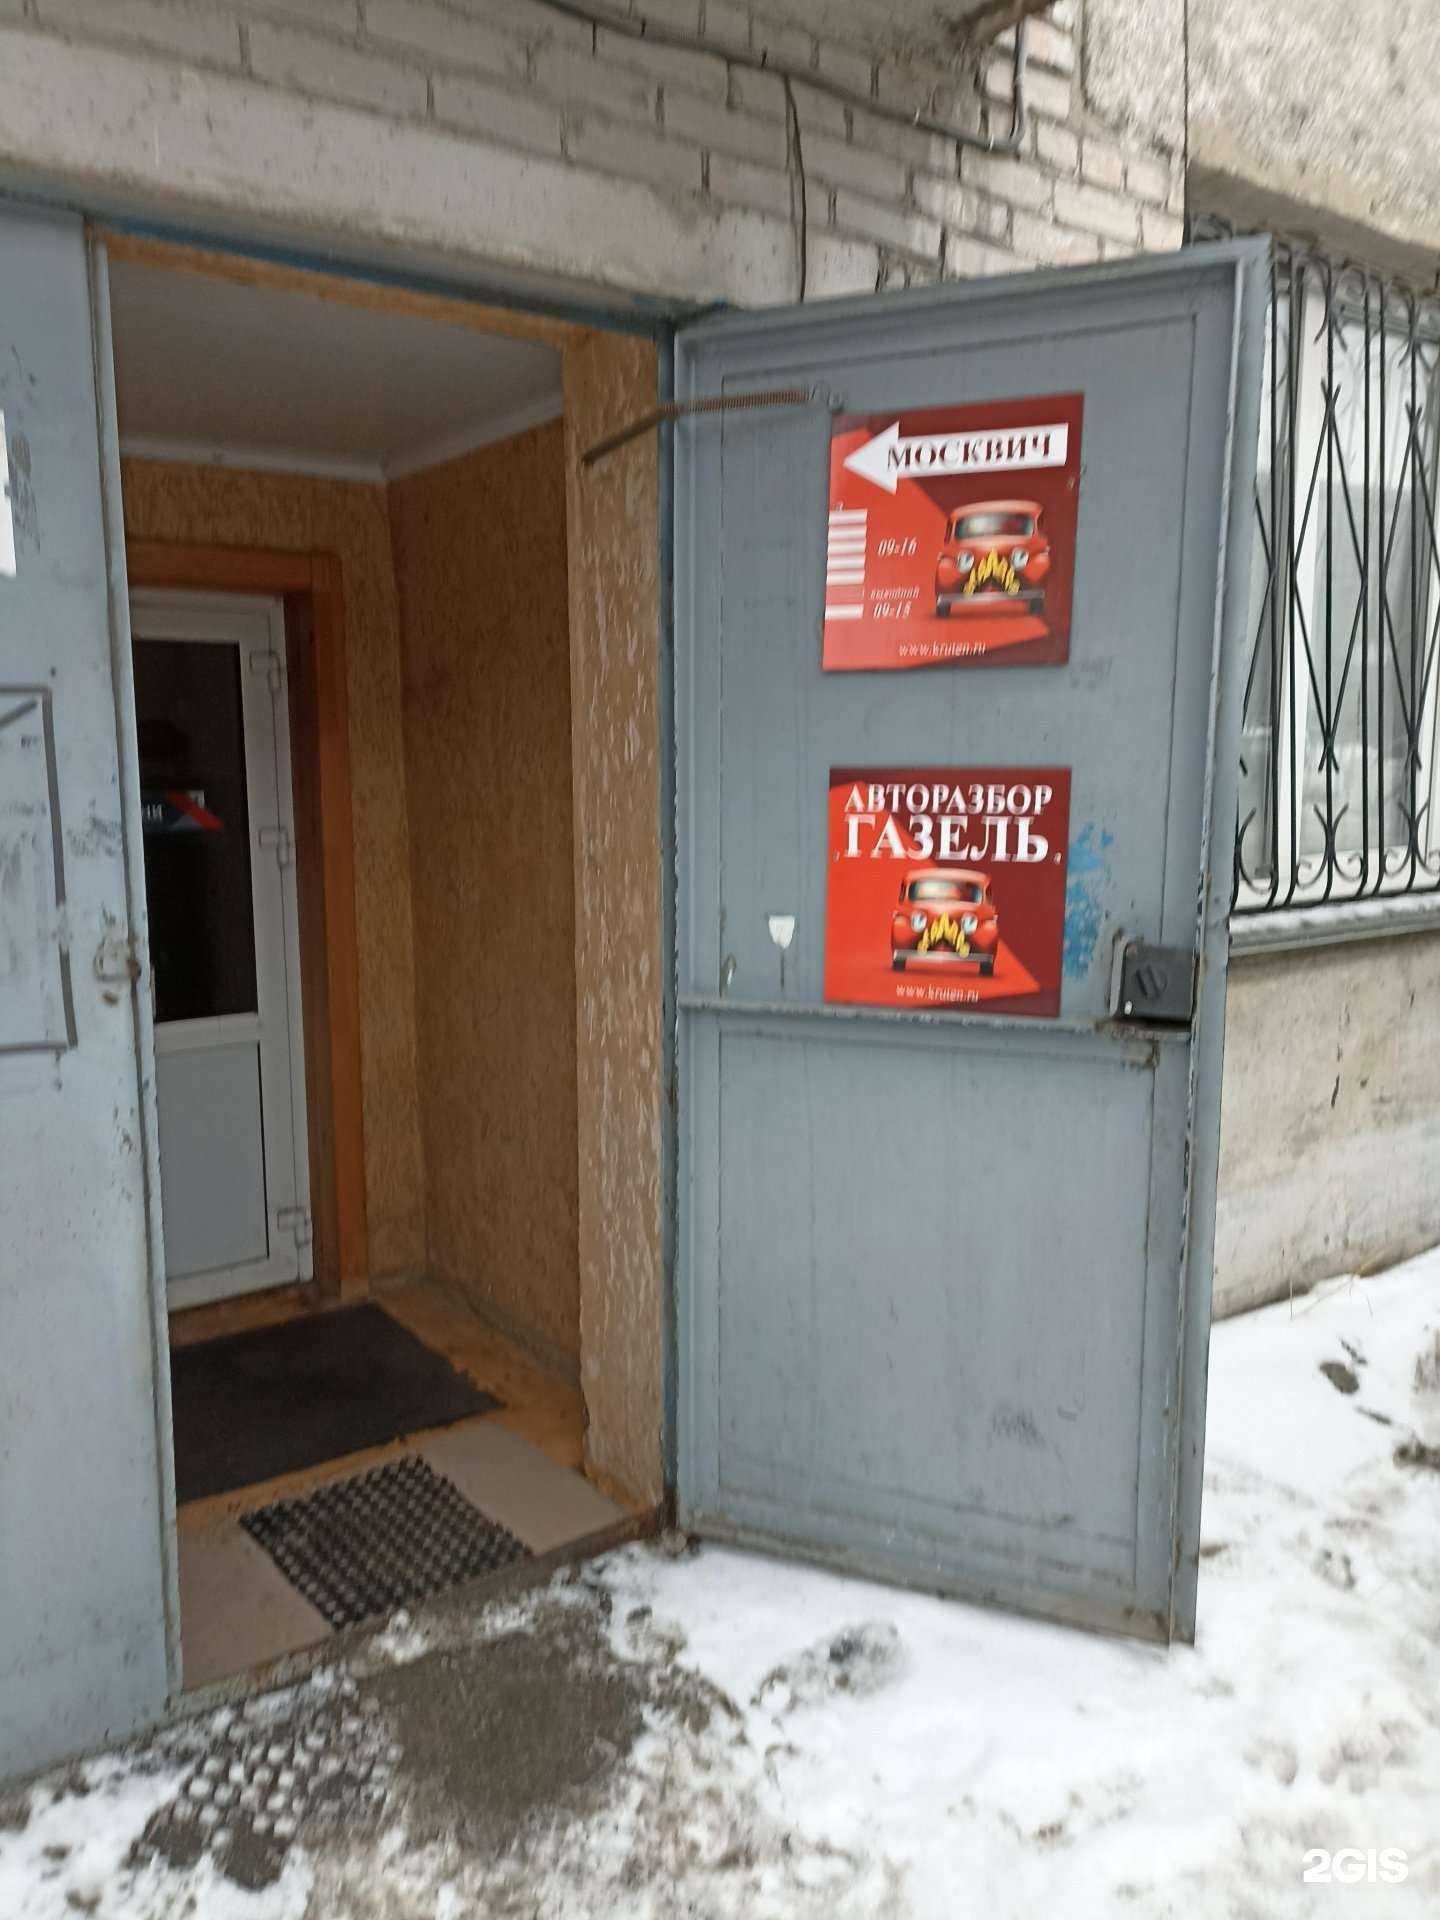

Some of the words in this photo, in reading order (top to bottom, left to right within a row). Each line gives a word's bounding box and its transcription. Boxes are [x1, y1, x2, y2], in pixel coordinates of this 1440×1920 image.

[887, 434, 1051, 472] МОСКВИЧ
[844, 783, 1053, 816] АВТОРАЗБОР
[844, 814, 1049, 863] ГАЗЕЛЬ
